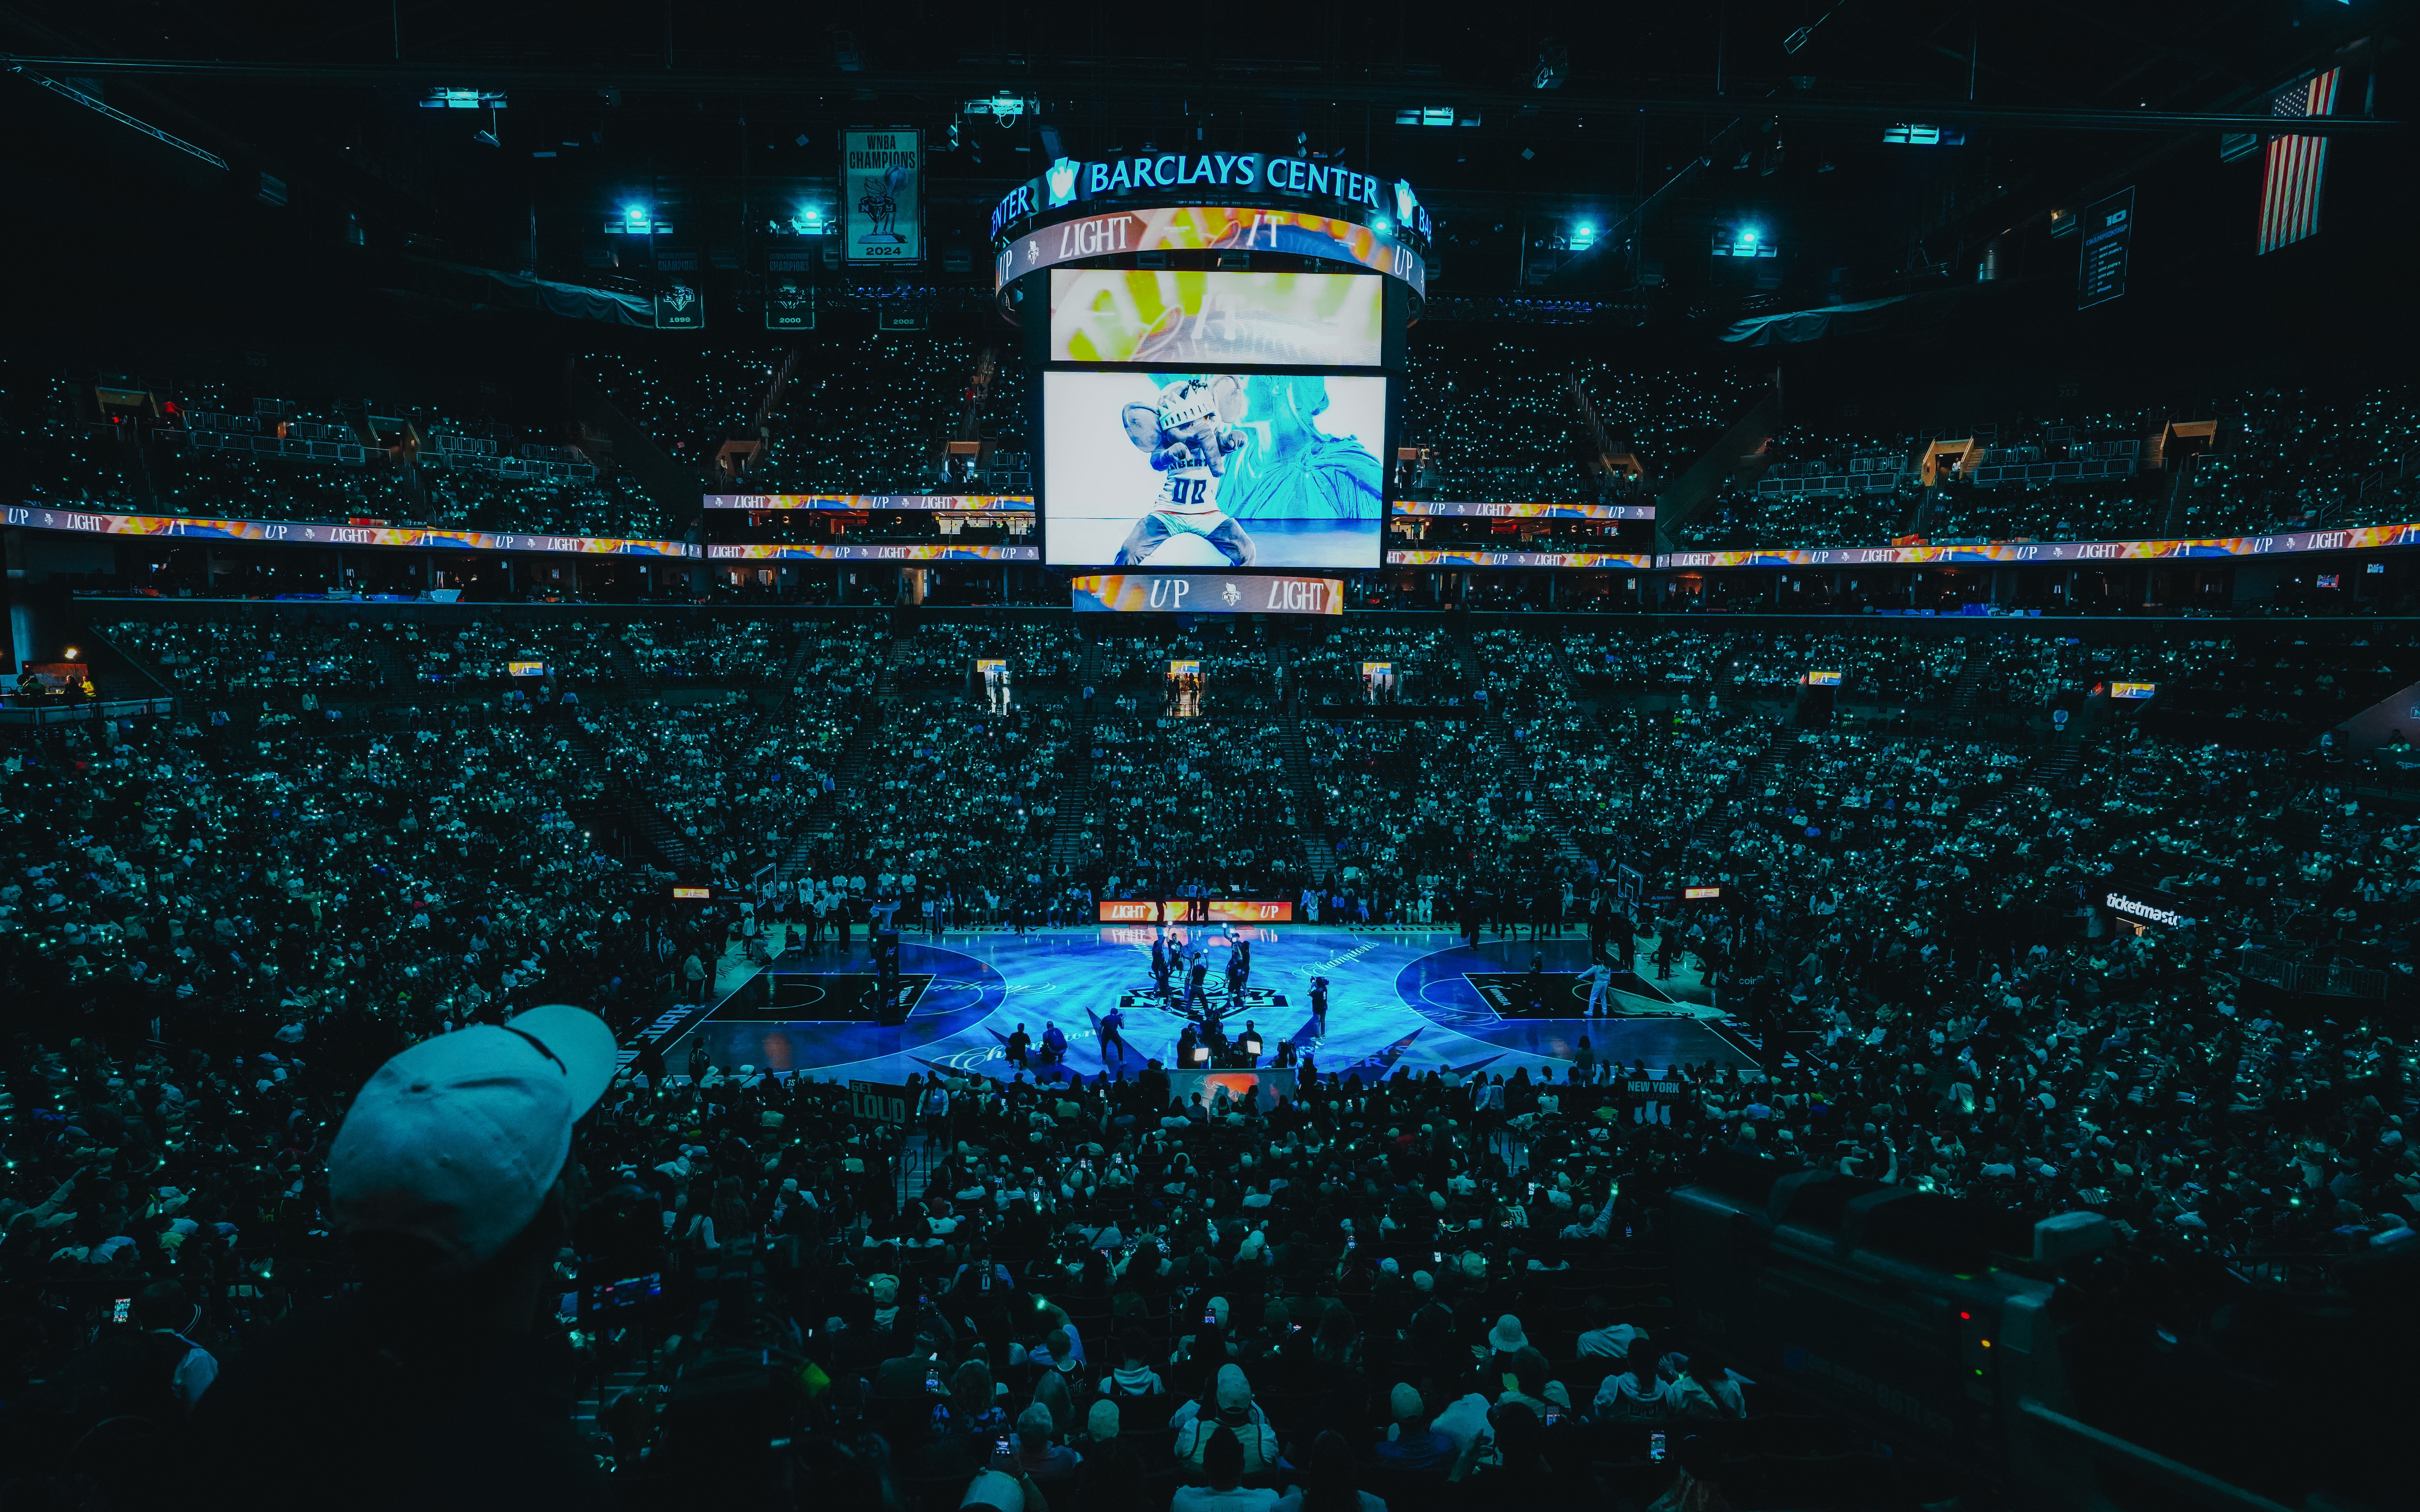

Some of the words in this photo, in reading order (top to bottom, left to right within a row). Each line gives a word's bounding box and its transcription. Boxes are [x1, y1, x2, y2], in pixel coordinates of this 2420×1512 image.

[867, 135, 896, 150] WNBA
[849, 151, 916, 169] CHAMPIONS
[1090, 155, 1254, 193] BARCLAYS
[1267, 159, 1379, 209] CENTER
[2105, 209, 2126, 227] 10
[866, 246, 902, 255] 2024
[1058, 216, 1132, 259] LIGHT
[1246, 214, 1284, 248] IT
[1394, 245, 1413, 281] UP
[769, 261, 809, 272] CHAMPIONS
[999, 250, 1012, 287] UP
[1171, 477, 1207, 504] 00
[734, 496, 765, 508] LIGHT
[872, 497, 889, 509] UP
[920, 497, 952, 509] LIGHT
[1428, 503, 1445, 515] UP
[8, 508, 29, 524] UP
[1475, 504, 1507, 516] LIGHT
[1608, 506, 1625, 518] UP
[67, 513, 103, 531] LIGHT
[168, 520, 186, 535] IT
[265, 526, 287, 539] UP
[330, 528, 370, 542] LIGHT
[420, 532, 437, 545] IT
[495, 536, 514, 548] UP
[547, 538, 579, 551] LIGHT
[2307, 532, 2347, 549] LIGHT
[2399, 527, 2416, 543] IT
[712, 546, 740, 557] LIGHT
[835, 547, 850, 558] UP
[878, 547, 906, 558] LIGHT
[1001, 548, 1016, 559] UP
[1860, 549, 1895, 562] LIGHT
[2017, 547, 2038, 560] UP
[2077, 544, 2119, 559] LIGHT
[2173, 543, 2191, 556] IT
[2254, 538, 2273, 552] UP
[1493, 554, 1508, 565] UP
[1535, 555, 1562, 566] LIGHT
[1656, 556, 1663, 567] UP
[1682, 554, 1711, 565] LIGHT
[1811, 551, 1829, 563] UP
[1150, 579, 1189, 608] UP
[1267, 580, 1324, 610] LIGHT
[1111, 905, 1146, 918] LIGHT
[1260, 905, 1279, 918] UP
[2107, 893, 2180, 926] ticketmast
[1292, 941, 1380, 978] Champions
[899, 986, 915, 1003] WNBA
[1489, 988, 1511, 1006] WNBA
[851, 1082, 872, 1093] GET
[1627, 1080, 1650, 1092] NEW
[1652, 1082, 1680, 1093] YORK
[852, 1092, 905, 1124] LOUD
